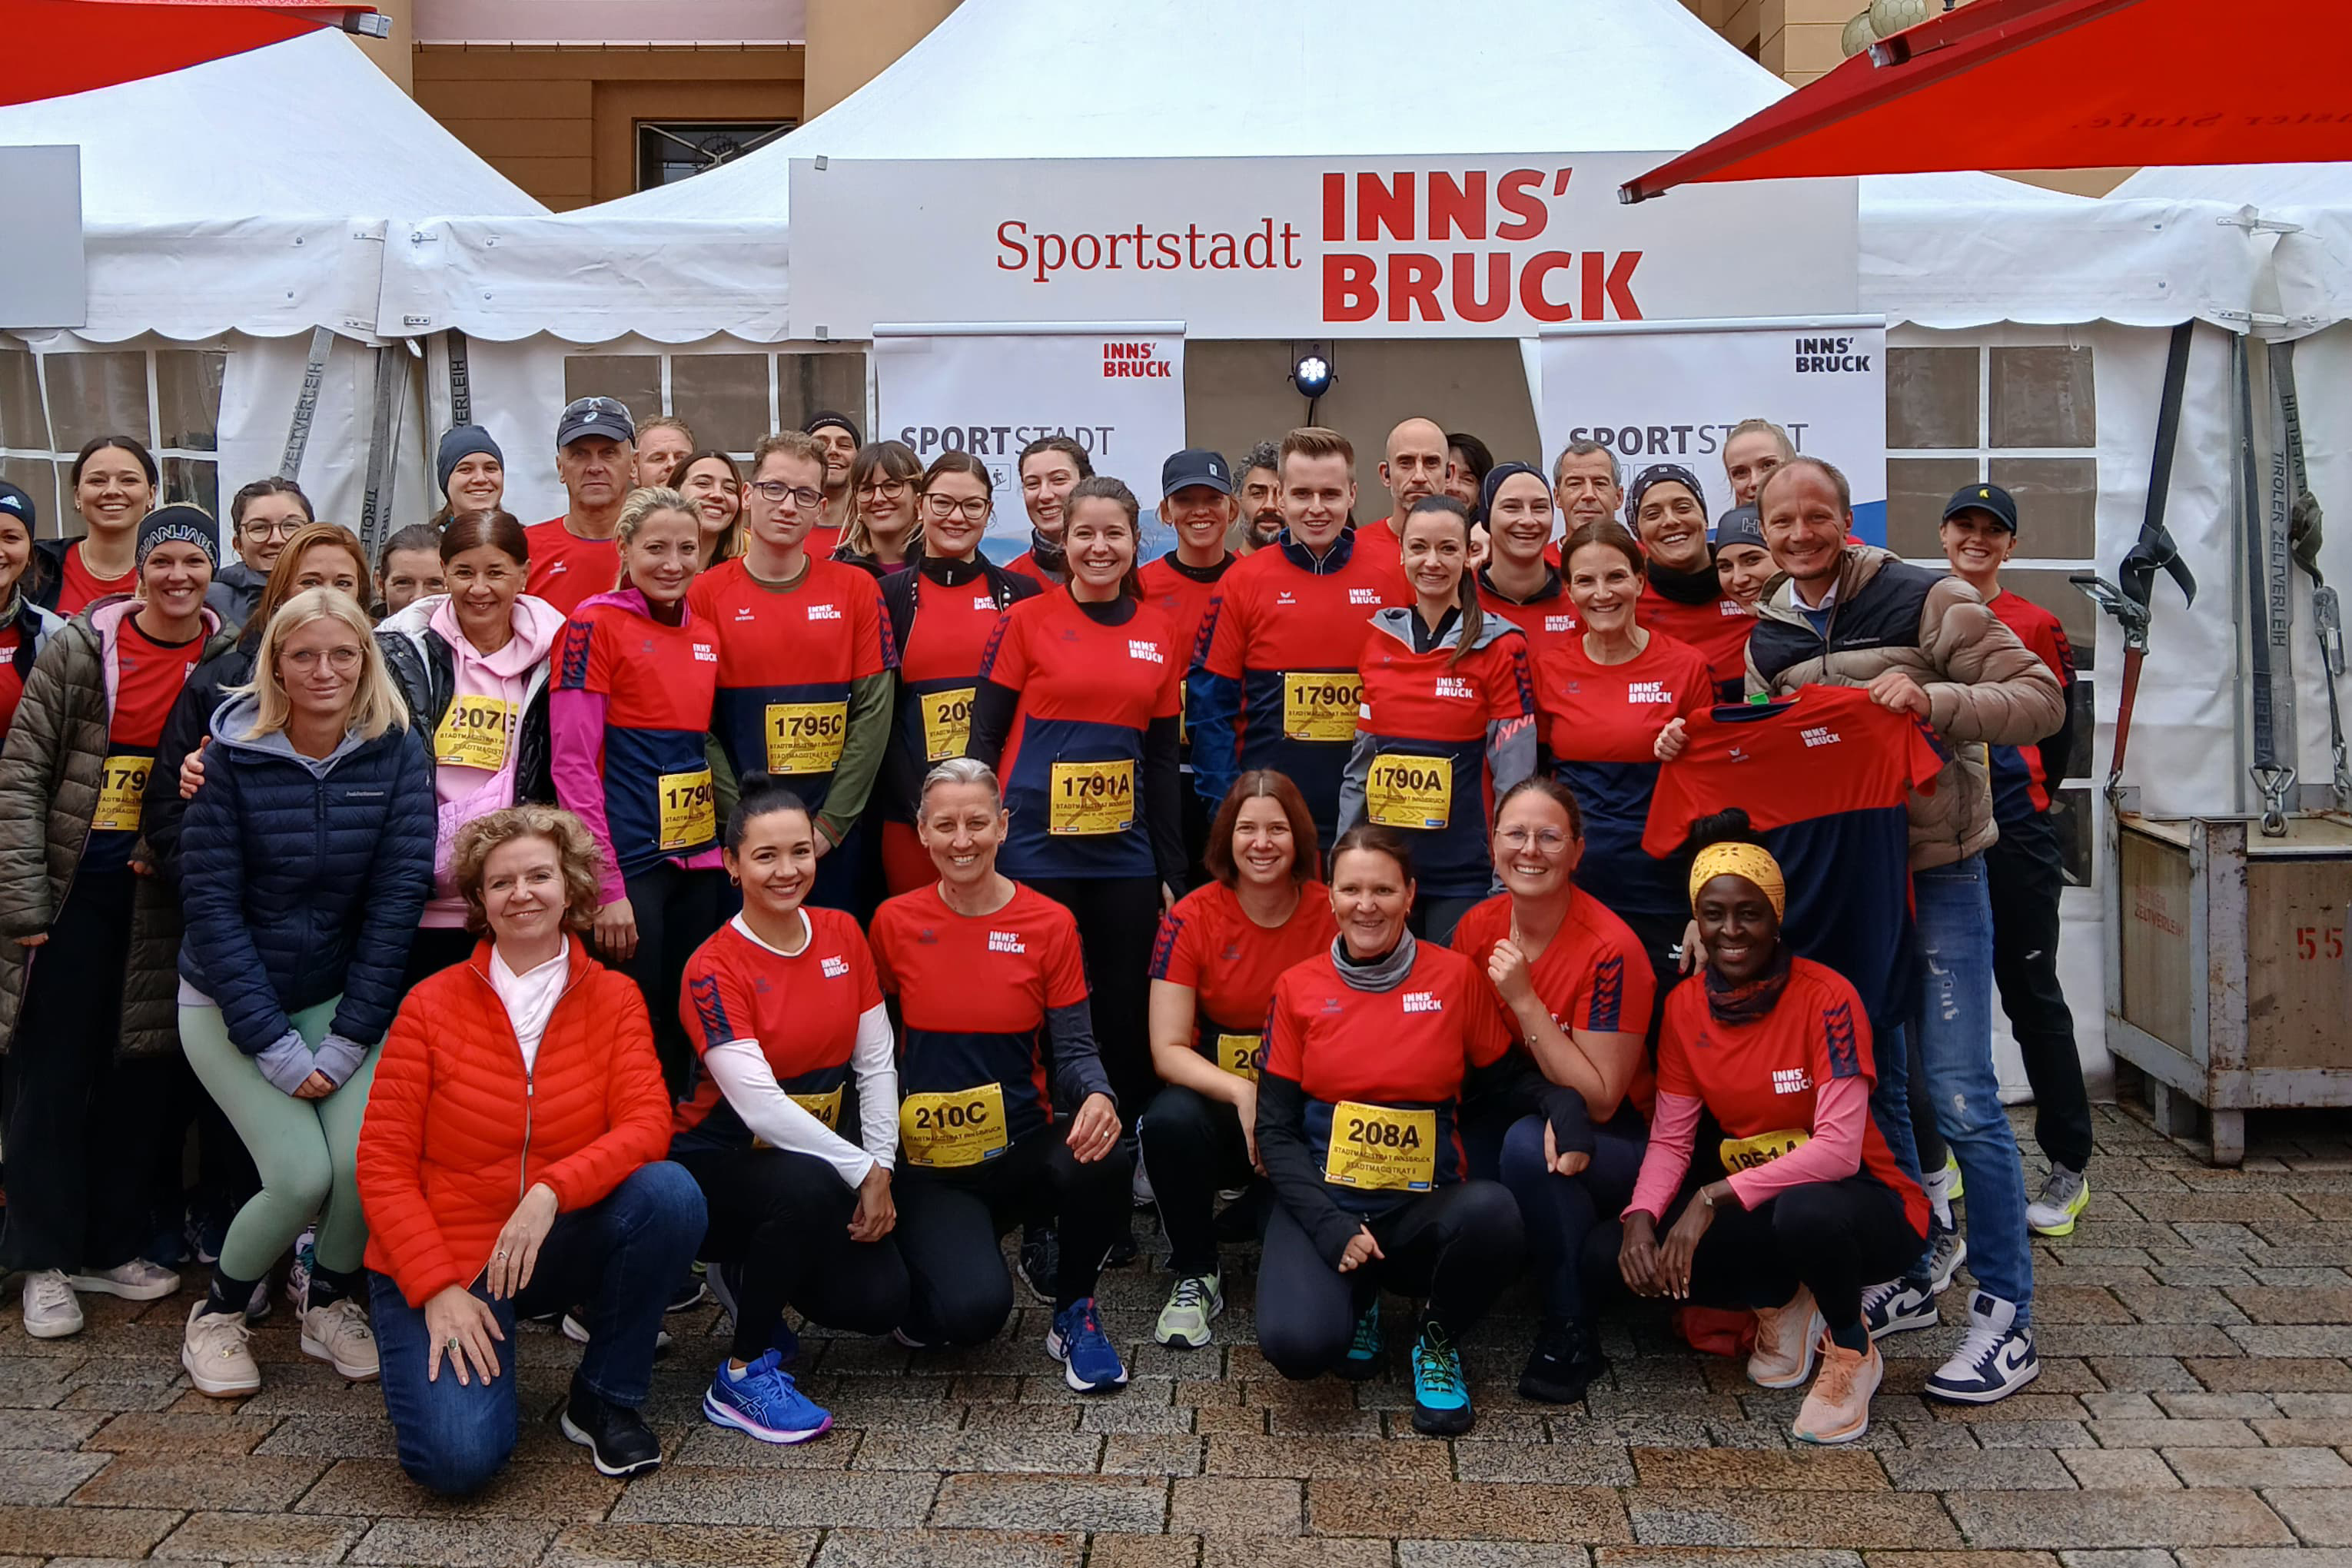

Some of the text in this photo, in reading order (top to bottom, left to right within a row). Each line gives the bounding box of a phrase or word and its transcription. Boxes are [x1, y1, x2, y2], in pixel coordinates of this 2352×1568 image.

[1322, 167, 1573, 241] INNS'
[995, 218, 1301, 283] Sportstadt
[1322, 251, 1643, 322] BRUCK
[1103, 343, 1156, 359] INNS'
[1796, 337, 1854, 354] INNS'
[1103, 360, 1171, 377] BRUCK
[1796, 354, 1871, 373] BRUCK
[453, 360, 471, 427] ERLEIH
[1570, 424, 1809, 455] SPORTSTT
[2281, 393, 2308, 492] LTVERLEIH
[2272, 451, 2287, 646] TIROLER ZELTVERLEIH
[1350, 596, 1381, 605] BRUCK
[808, 610, 842, 620] BRUCK
[1129, 647, 1164, 665] BRUCK
[1434, 687, 1473, 698] BRUCK
[1629, 692, 1673, 703] BRUCK
[775, 714, 842, 737] 1795C
[101, 769, 147, 791] 179
[1062, 773, 1130, 796] 1791A
[1374, 767, 1443, 792] 1790A
[666, 782, 713, 809] 1790
[988, 940, 1026, 954] BRUCK
[1403, 999, 1442, 1013] BRUCK
[915, 1101, 988, 1129] 210C
[1348, 1118, 1420, 1148] 208A
